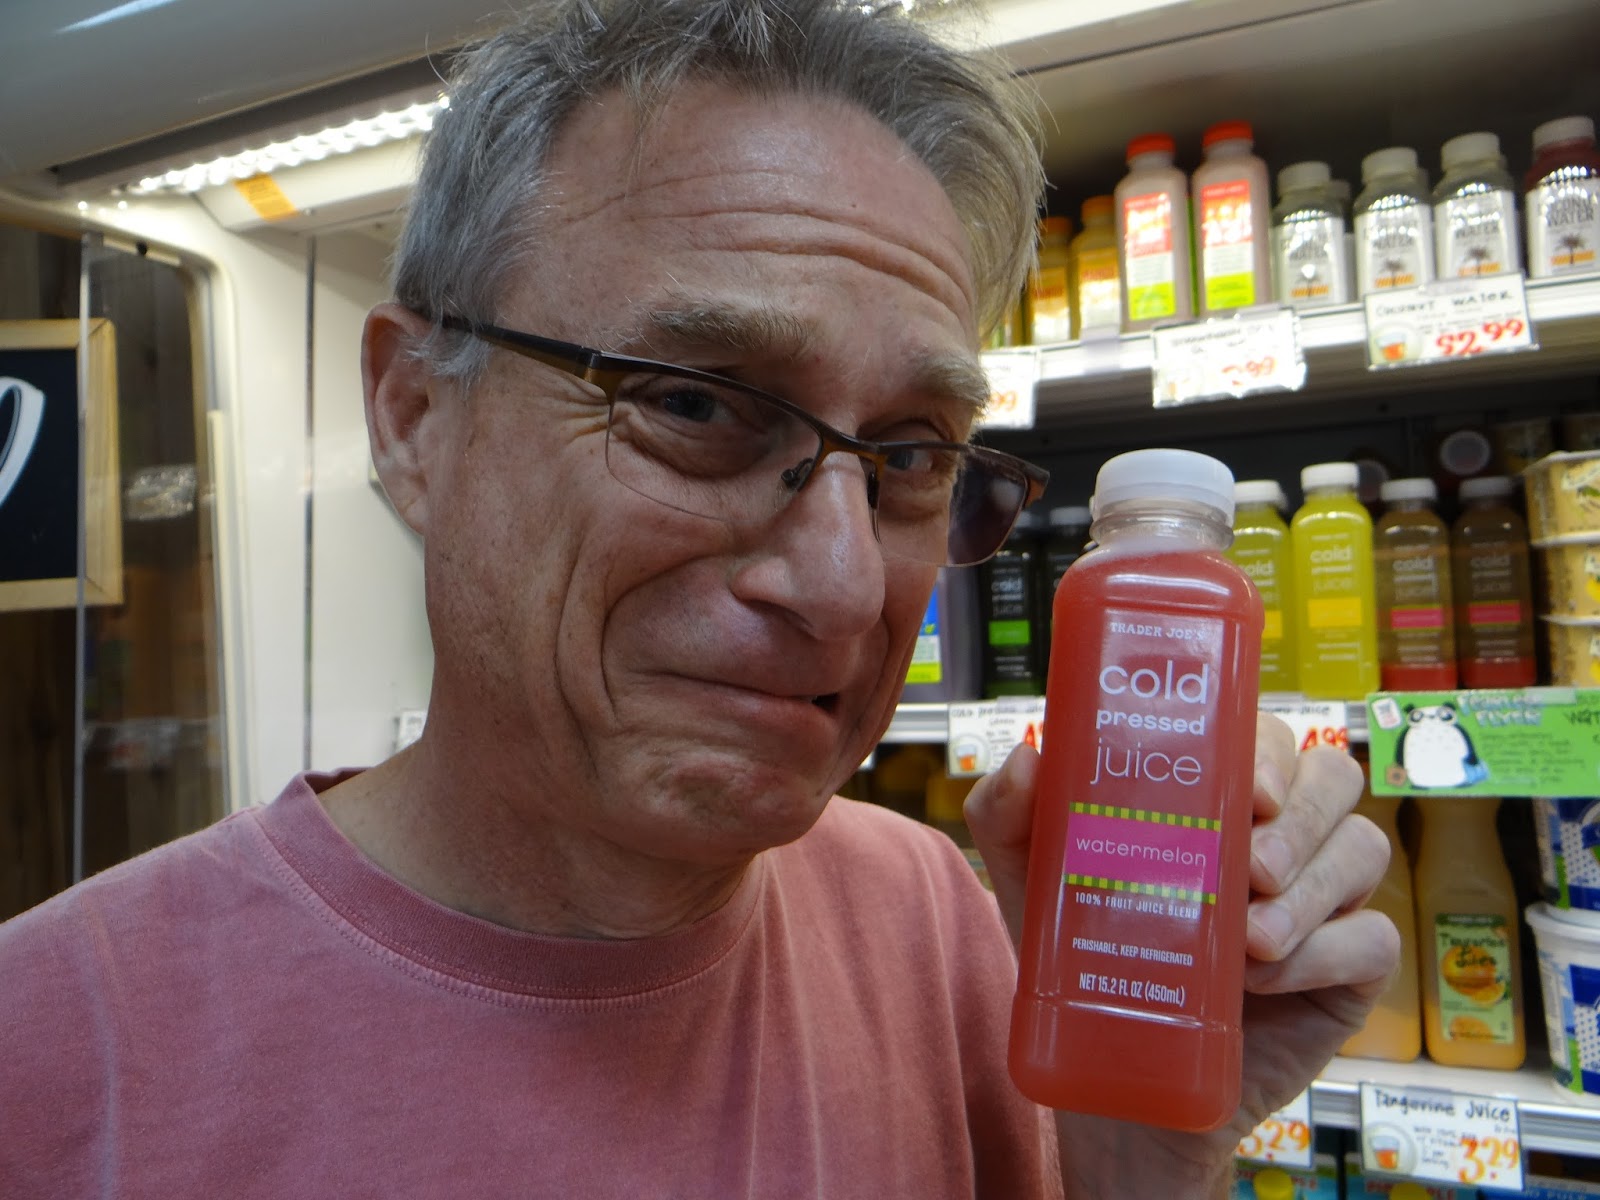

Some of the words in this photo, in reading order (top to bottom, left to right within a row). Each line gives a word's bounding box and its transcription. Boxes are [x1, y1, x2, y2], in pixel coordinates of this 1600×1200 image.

[1110, 622, 1162, 638] TRADER
[1166, 627, 1206, 641] JOE'S
[1099, 660, 1209, 705] cold
[1096, 709, 1205, 736] pressed
[1090, 737, 1202, 785] juice
[1076, 837, 1206, 867] watermelon
[1075, 891, 1101, 906] 100%
[1105, 895, 1133, 911] FRUIT
[1136, 900, 1164, 915] JUICE
[1168, 904, 1199, 919] BLEND
[1072, 937, 1119, 956] PERISHABLE,
[1120, 944, 1139, 957] KEEP
[1140, 947, 1193, 966] REFRIGERATED
[1079, 972, 1097, 991] NET
[1098, 975, 1116, 995] 15.2
[1119, 978, 1128, 996] FL
[1130, 981, 1142, 998] OZ
[1145, 980, 1185, 1007] (450mL)
[1466, 1101, 1511, 1121] Juice
[1459, 1135, 1520, 1184] 3.29
